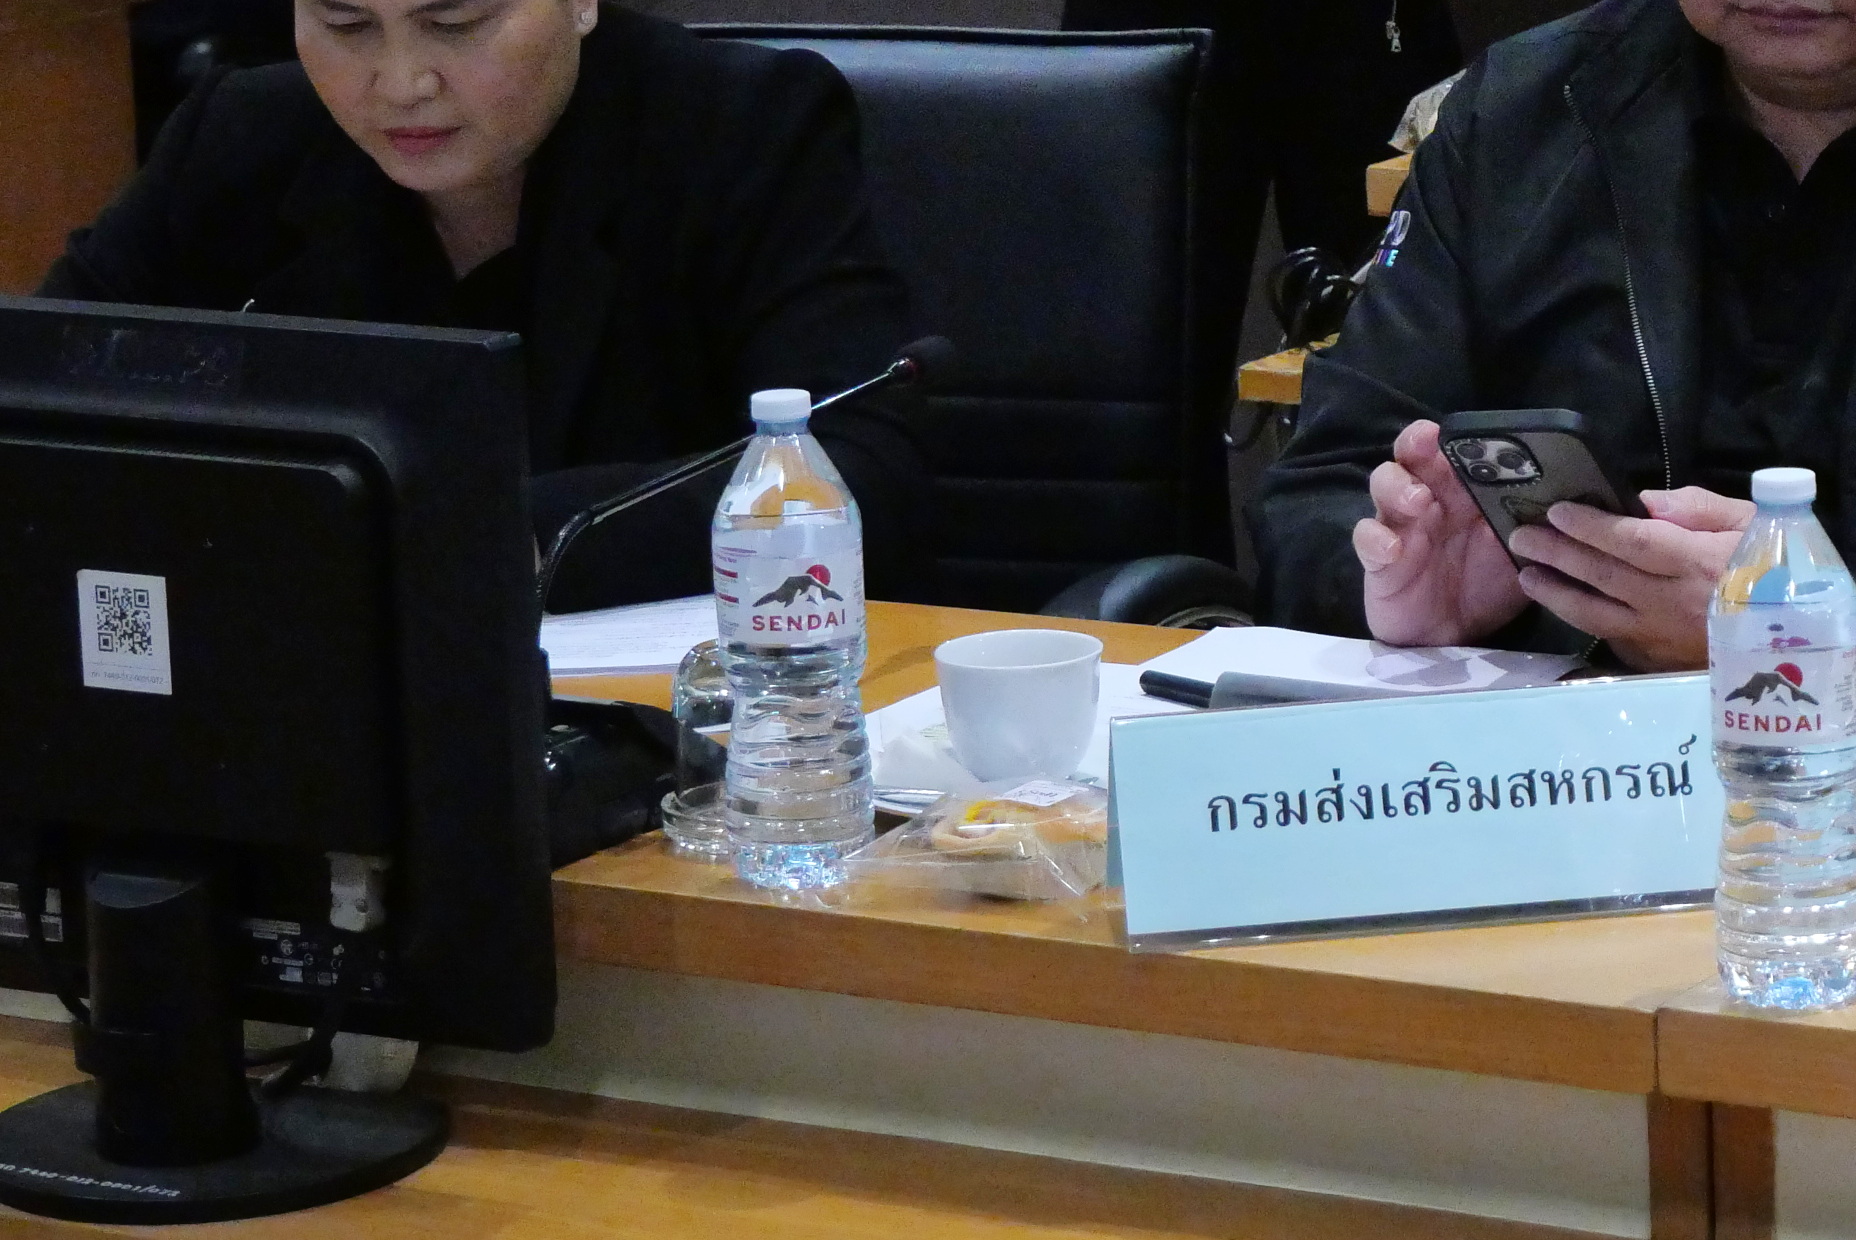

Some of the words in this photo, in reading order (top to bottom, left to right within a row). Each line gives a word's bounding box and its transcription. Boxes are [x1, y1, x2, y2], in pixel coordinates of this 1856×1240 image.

[752, 608, 846, 632] SENDAI
[1724, 710, 1822, 733] SENDAI
[1208, 734, 1698, 832] กรมส่งเสริมสหกรณ์
